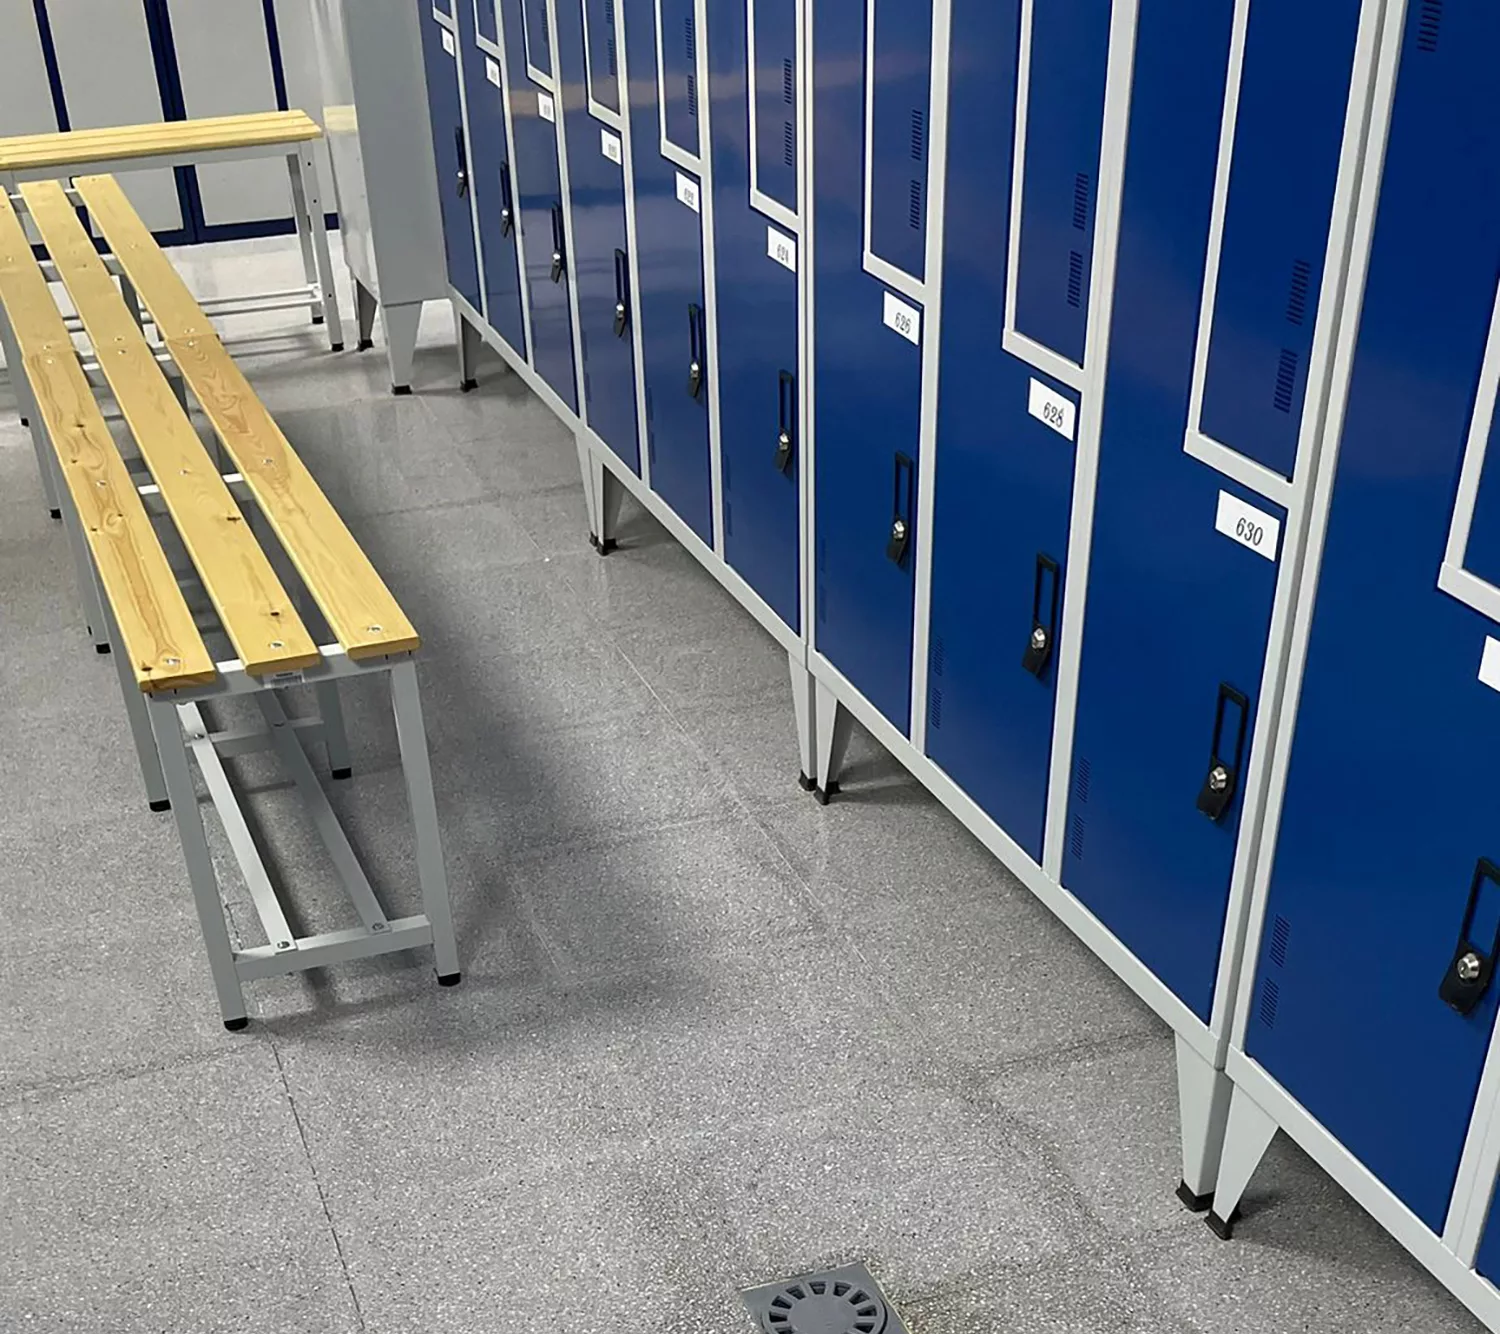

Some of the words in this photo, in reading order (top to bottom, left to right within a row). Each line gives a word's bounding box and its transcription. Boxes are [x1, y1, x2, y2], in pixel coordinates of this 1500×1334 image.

[895, 312, 911, 334] 626
[1043, 401, 1065, 428] 628
[1236, 517, 1264, 546] 630
